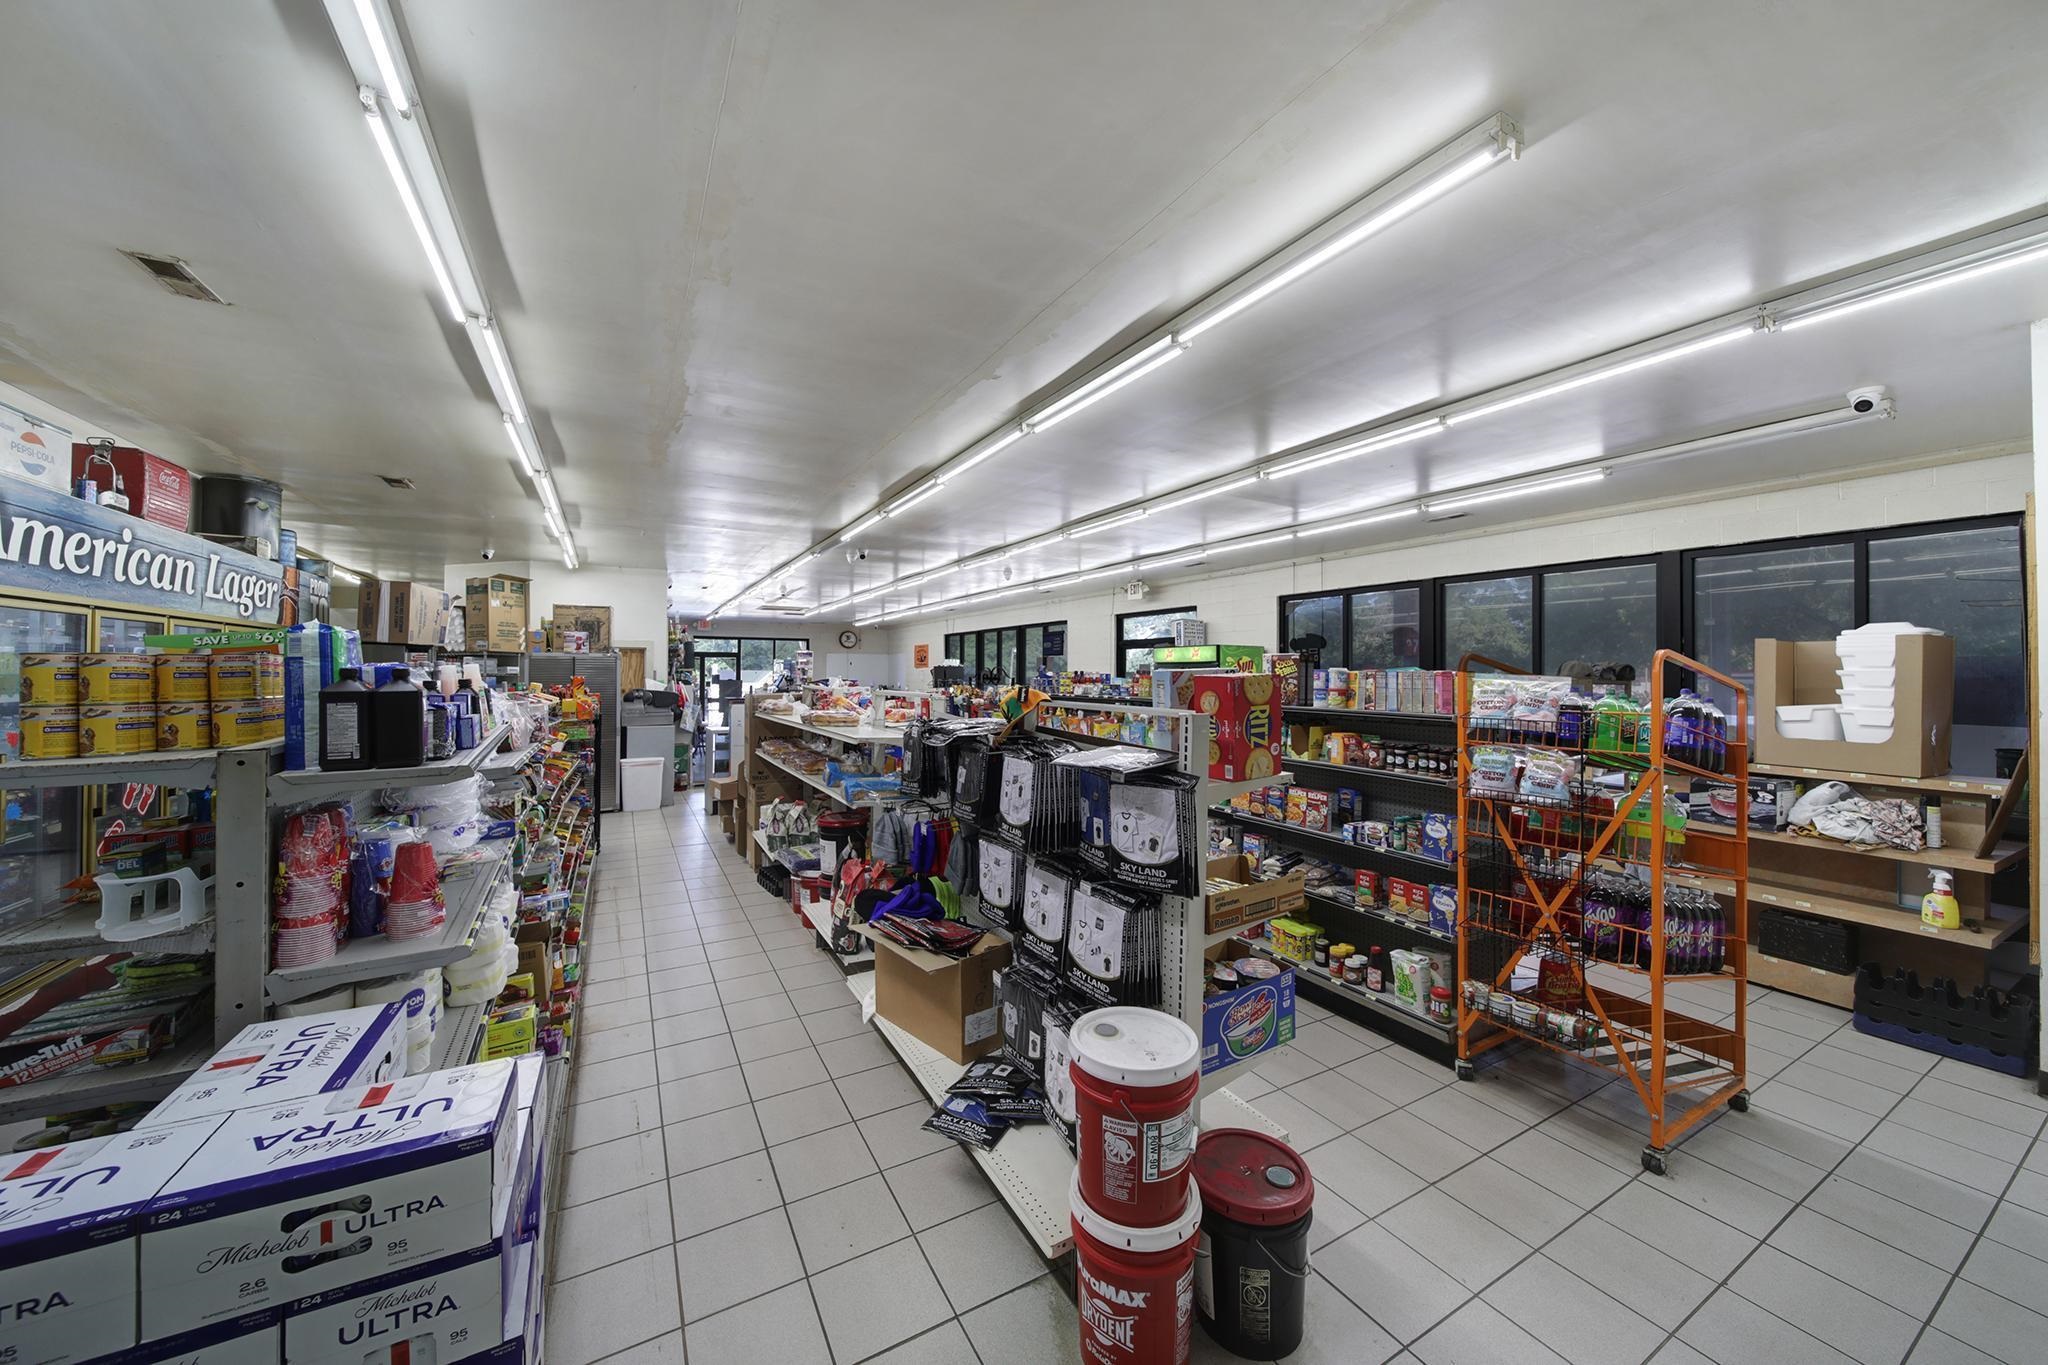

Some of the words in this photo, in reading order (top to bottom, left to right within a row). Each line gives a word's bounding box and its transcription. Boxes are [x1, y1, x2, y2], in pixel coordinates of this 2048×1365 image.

[0, 516, 195, 595] merican
[205, 554, 278, 617] Lager
[1129, 583, 1140, 596] EXIT
[193, 635, 230, 646] SAVE
[1250, 705, 1270, 749] RITZ
[1479, 769, 1506, 777] COTTON
[1482, 774, 1504, 782] CANDY
[1120, 861, 1137, 873] SKY
[1139, 863, 1167, 878] LAND
[1149, 880, 1171, 889] WEIGHT
[1215, 915, 1239, 928] Ramen
[1584, 906, 1616, 934] Faygo
[1025, 933, 1039, 946] SKY
[1037, 939, 1055, 954] LAND
[1072, 967, 1088, 981] SKY
[1087, 974, 1110, 993] LAND
[1431, 999, 1448, 1014] Jif
[307, 1024, 360, 1069] Michelob
[245, 1022, 336, 1094] ULTRA
[1016, 1051, 1035, 1071] LAND
[10, 1071, 34, 1085] 12
[984, 1078, 1008, 1086] LAND
[253, 1097, 453, 1152] ULTRA
[271, 1110, 299, 1122] 95
[940, 1113, 960, 1125] SKY
[959, 1117, 987, 1133] LAND
[1053, 1109, 1069, 1135] LAND
[1108, 1119, 1137, 1130] WARNING
[1108, 1125, 1128, 1134] AVISO
[267, 1119, 422, 1166] Michelob
[1149, 1135, 1159, 1170] 80W-90
[157, 1209, 183, 1225] 24
[345, 1195, 446, 1234] ULTRA
[196, 1230, 311, 1274] Michelob
[387, 1238, 408, 1251] 95
[238, 1285, 270, 1299] CARBS
[239, 1277, 267, 1293] 2.6
[301, 1295, 322, 1309] 24
[355, 1280, 438, 1319] Michelob
[338, 1295, 456, 1346] ULTRA
[1081, 1283, 1135, 1349] DRYDENE
[450, 1328, 469, 1342] 95
